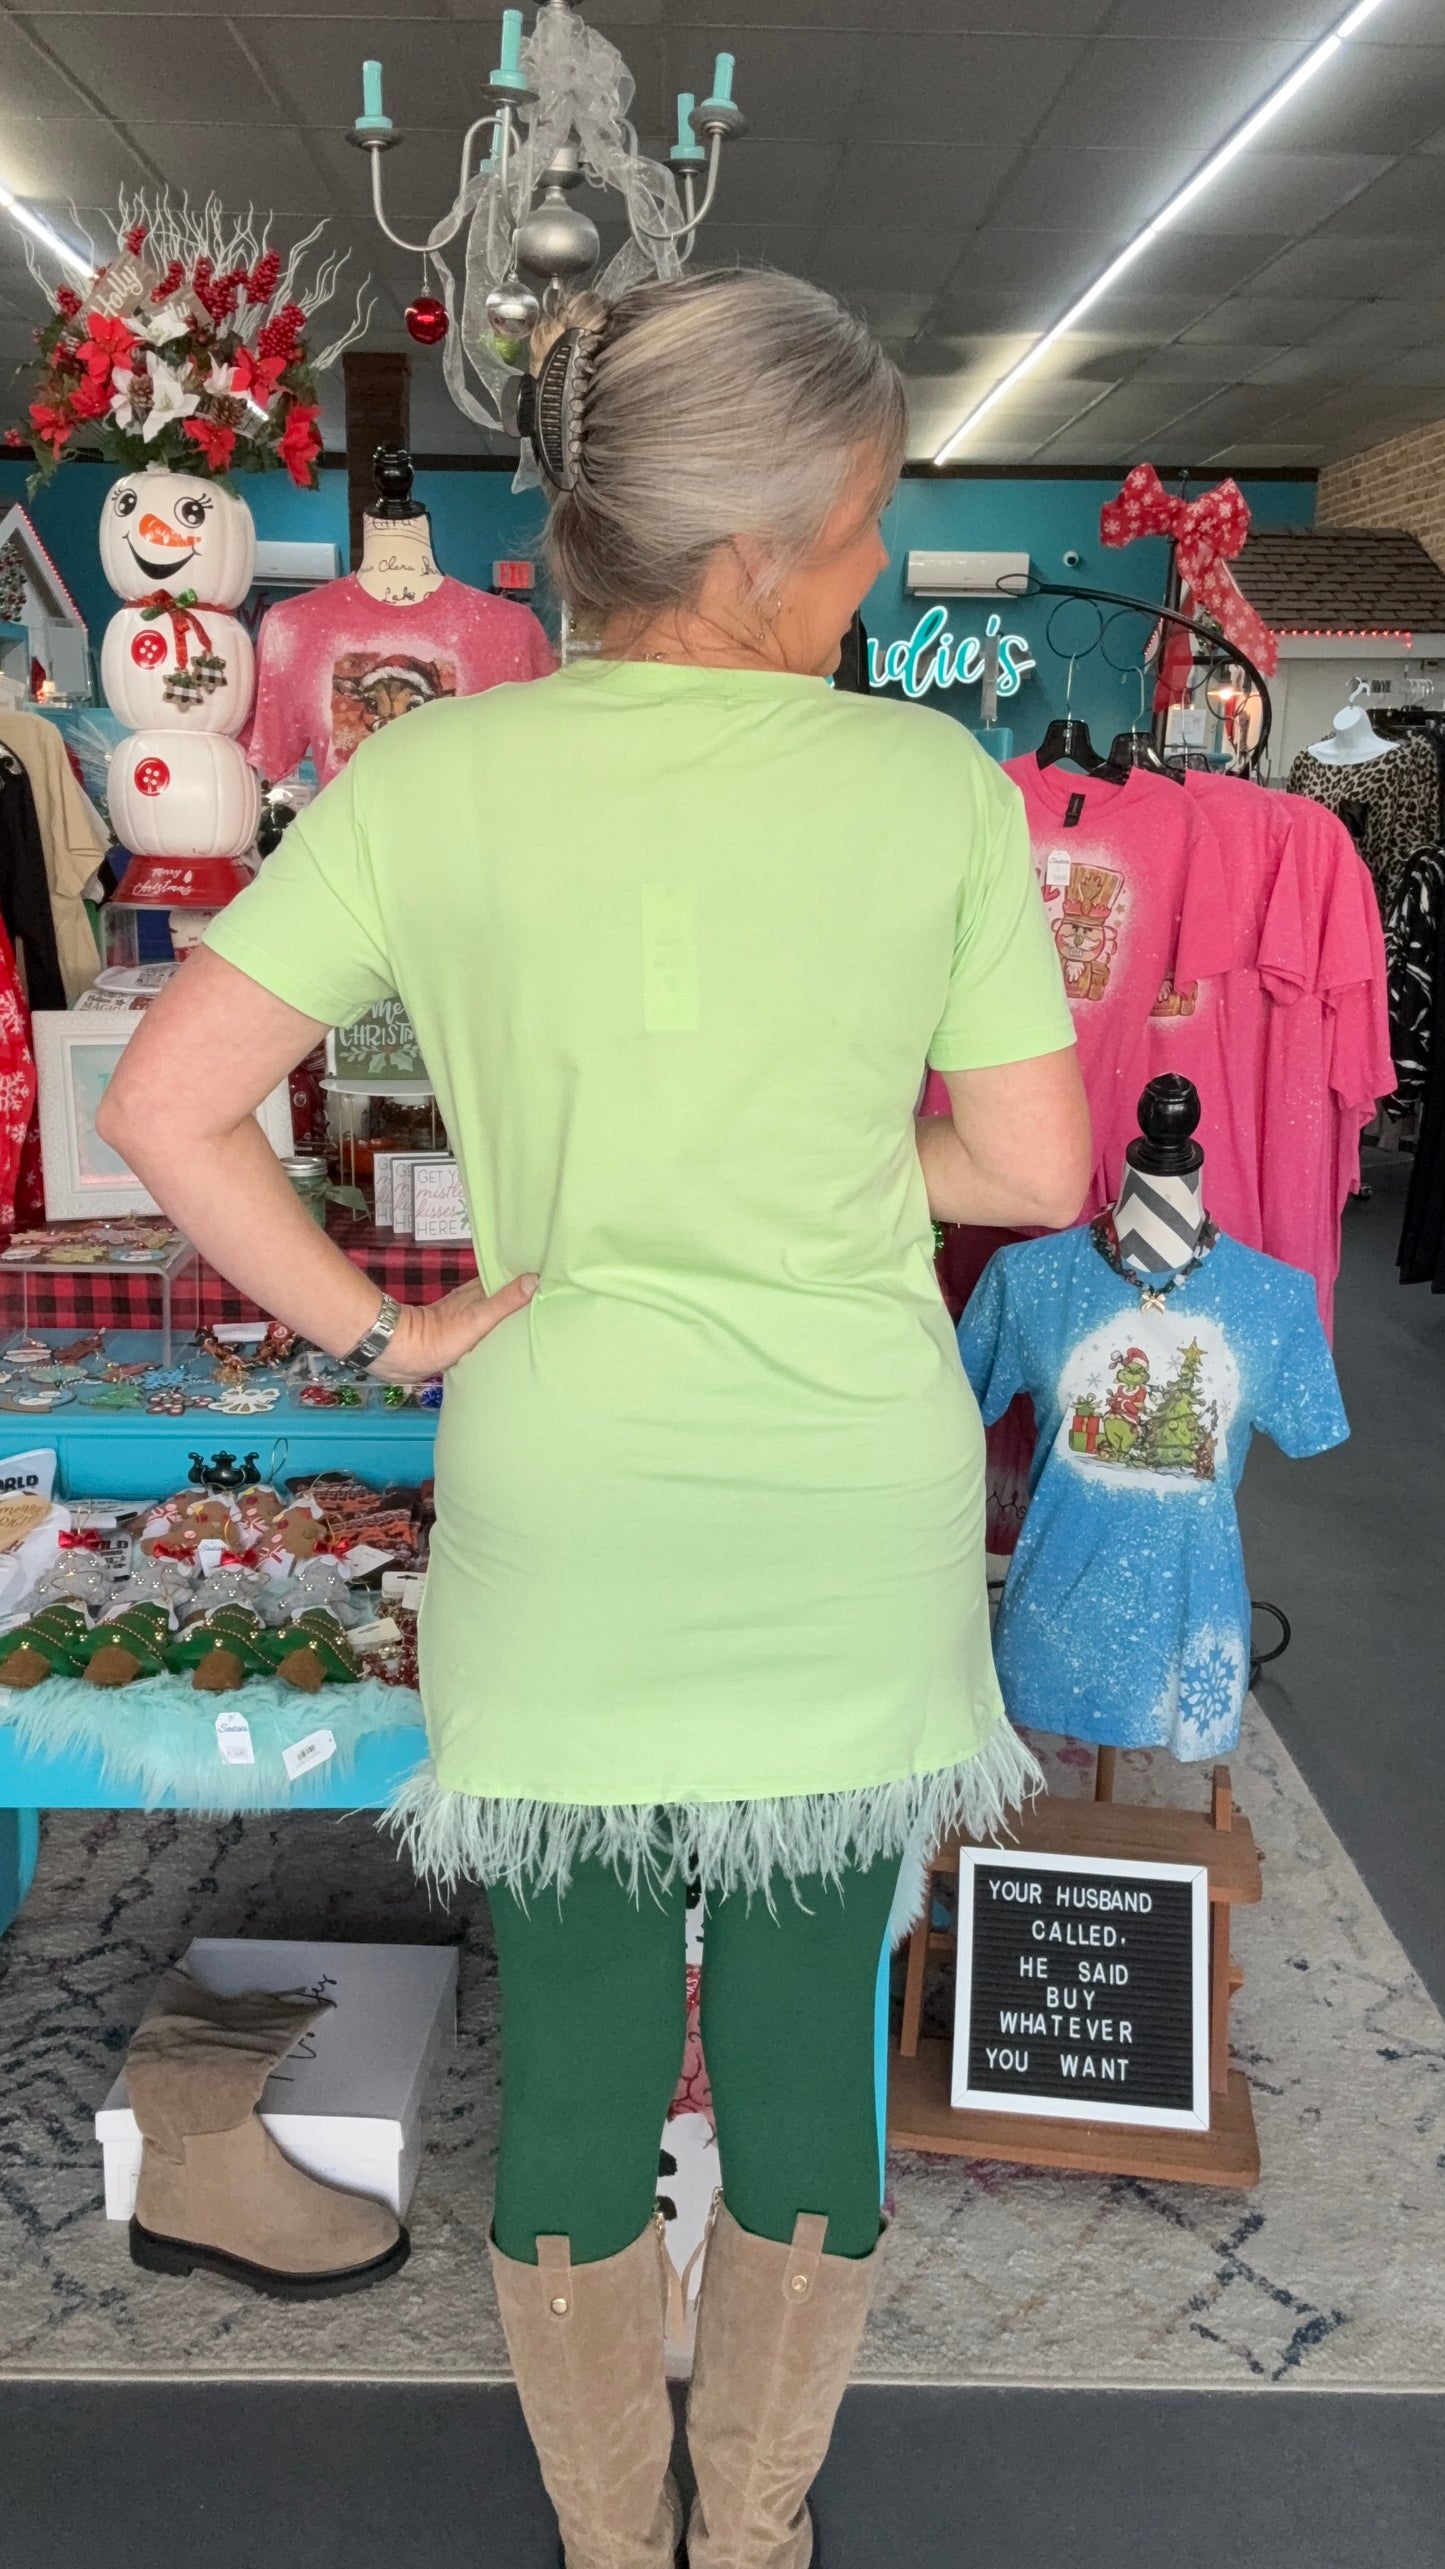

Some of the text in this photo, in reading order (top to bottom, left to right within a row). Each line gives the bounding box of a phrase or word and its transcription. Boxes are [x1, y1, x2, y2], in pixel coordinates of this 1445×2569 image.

[89, 265, 143, 317] Holly
[866, 605, 1036, 697] die's
[417, 1169, 443, 1184] GET
[416, 1219, 458, 1237] HERE
[990, 1880, 1152, 1913] YOUR HUSBAND
[1020, 1956, 1129, 1985] HE SAID
[1046, 1986, 1095, 2010] BUY
[1000, 2011, 1133, 2043] WHATEVER
[986, 2048, 1129, 2081] YOU WANT
